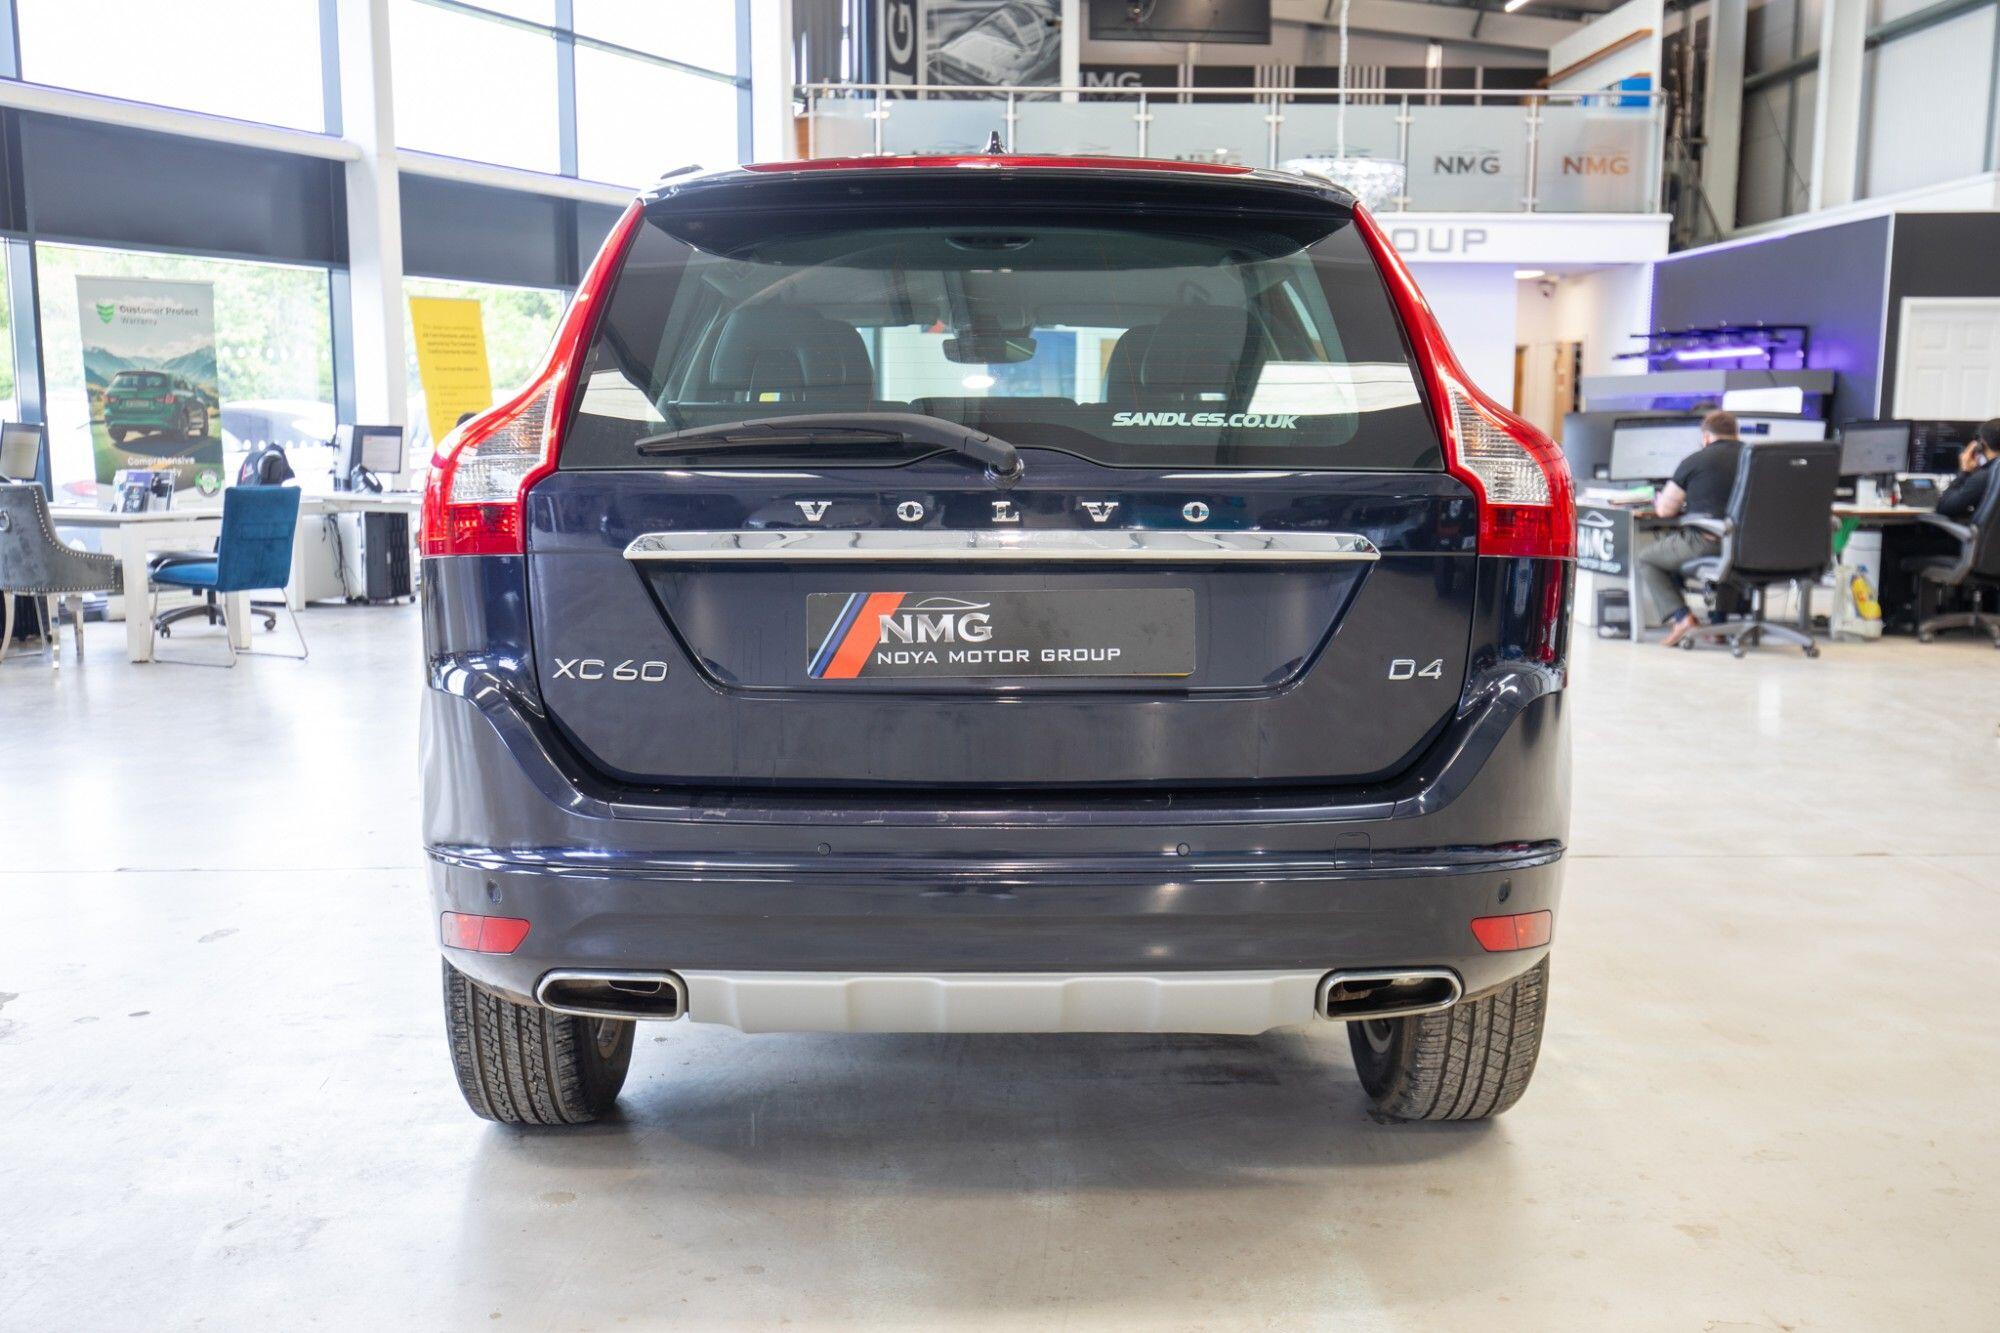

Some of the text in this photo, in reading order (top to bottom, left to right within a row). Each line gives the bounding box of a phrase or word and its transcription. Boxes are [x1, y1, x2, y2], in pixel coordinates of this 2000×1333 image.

[1433, 156, 1500, 174] NMG
[1563, 156, 1630, 174] NMG
[1391, 228, 1487, 252] OUP
[120, 304, 198, 316] Customer Protect
[1112, 412, 1300, 429] SANDLES.CO.UK
[127, 456, 195, 466] Comprehensive
[795, 501, 1210, 522] VOLVO
[878, 612, 993, 644] NMG
[877, 647, 1121, 665] NOYA MOTOR GROUP
[1389, 659, 1443, 680] D4
